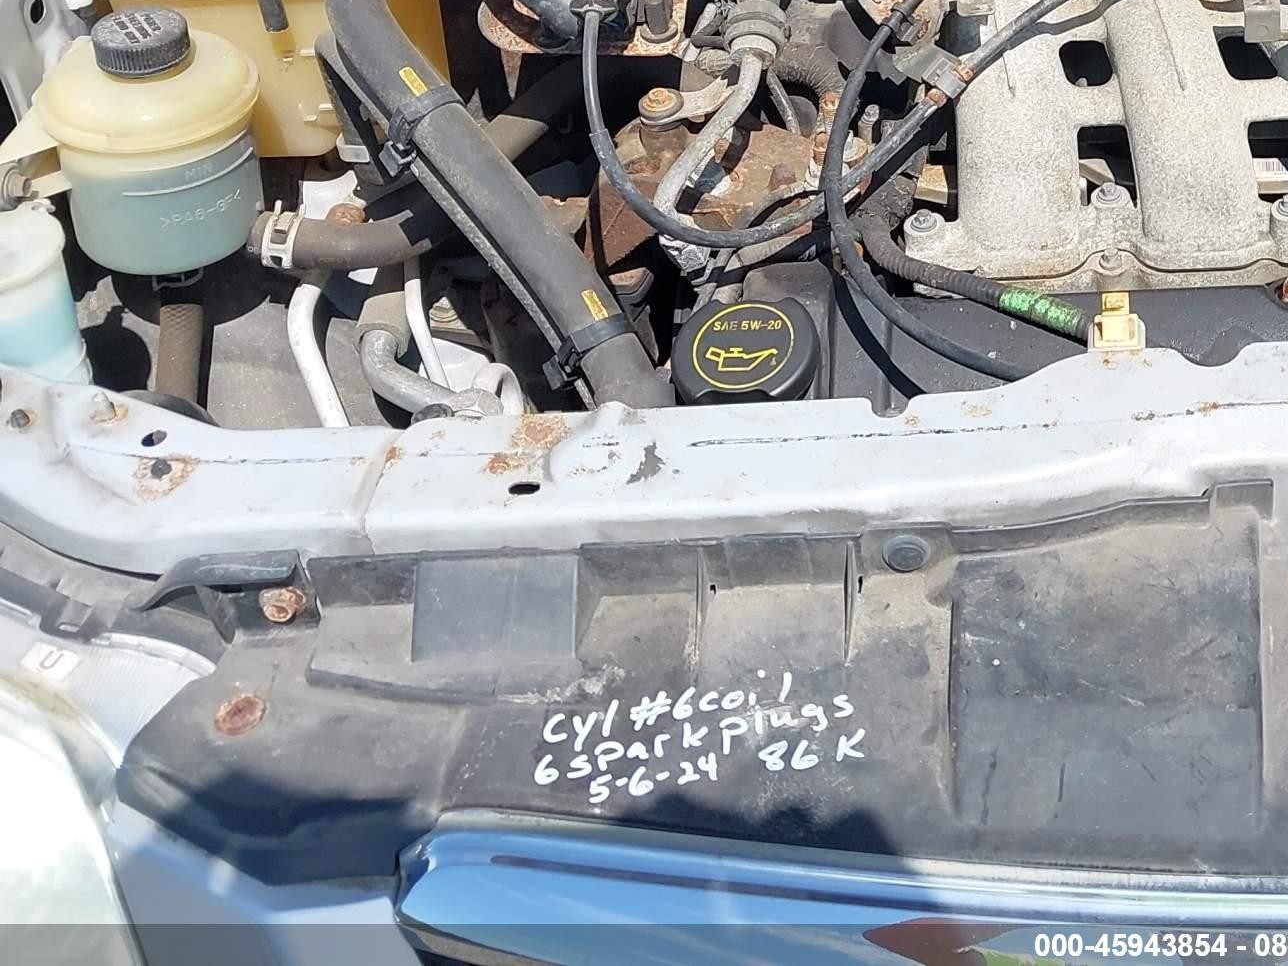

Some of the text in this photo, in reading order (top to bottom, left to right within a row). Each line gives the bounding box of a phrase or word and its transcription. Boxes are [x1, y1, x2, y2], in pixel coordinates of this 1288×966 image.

[713, 319, 782, 332] SAE 5W-20
[588, 752, 718, 804] 5-6-24
